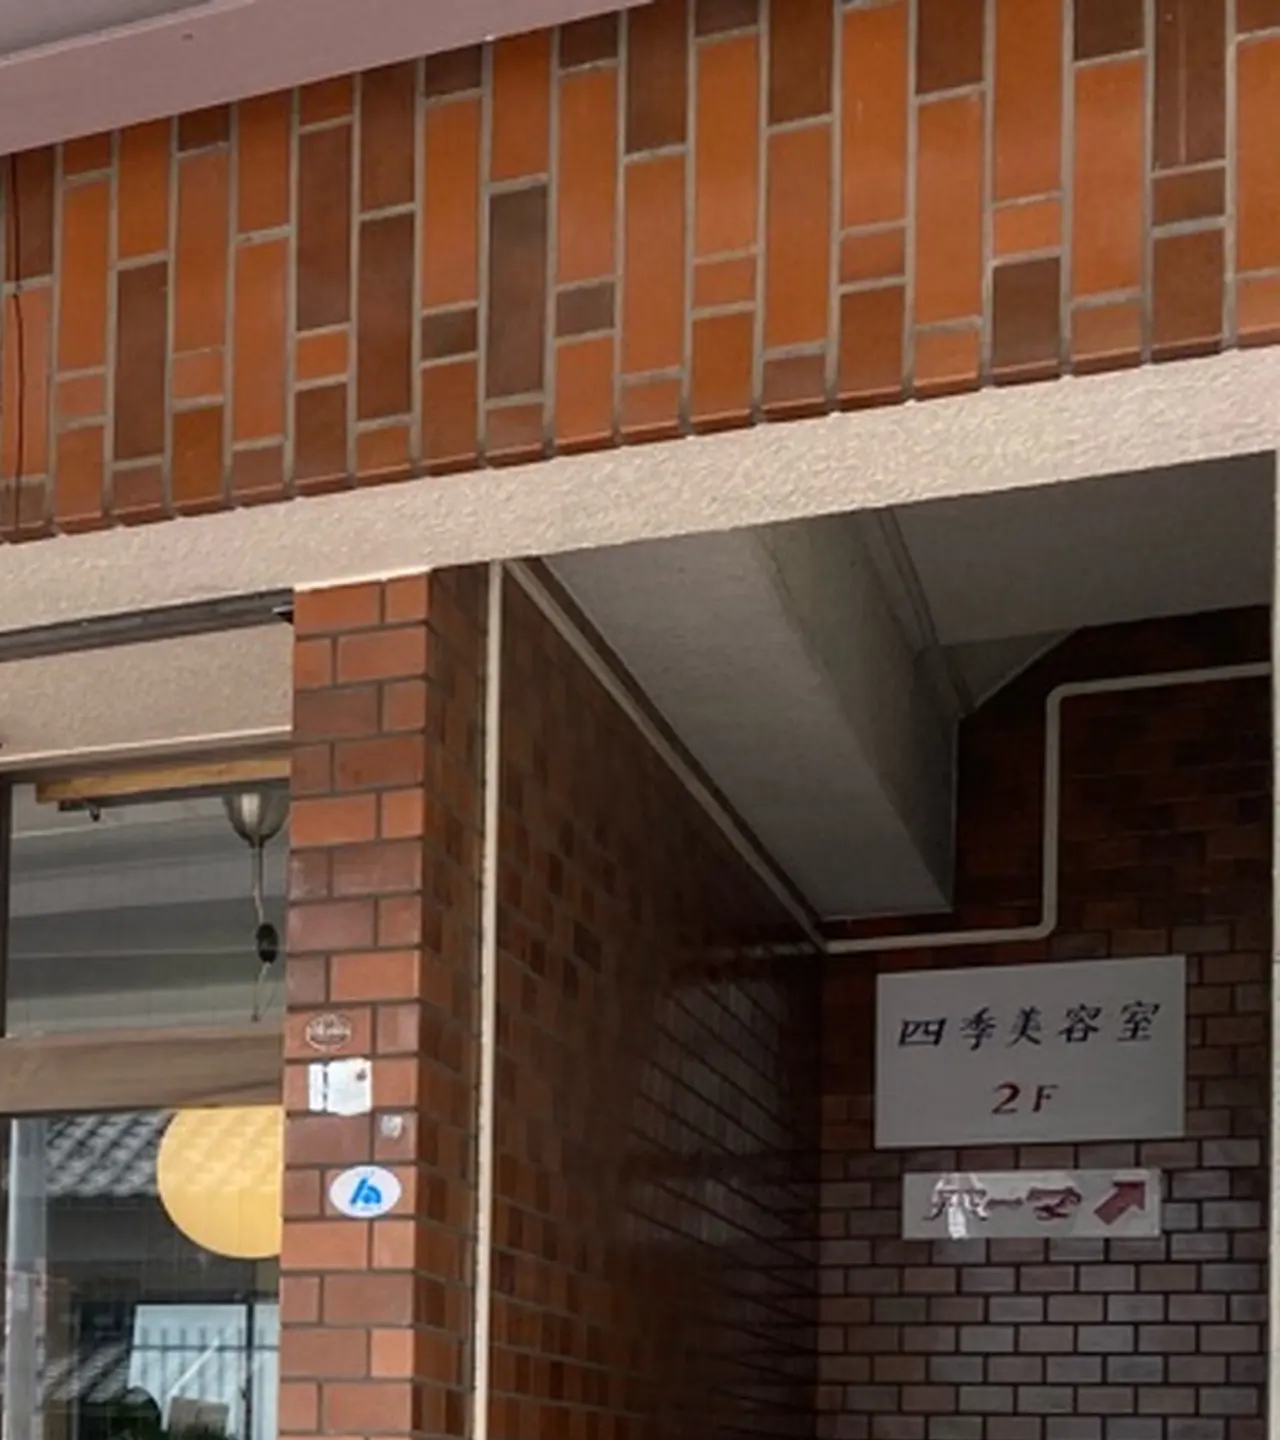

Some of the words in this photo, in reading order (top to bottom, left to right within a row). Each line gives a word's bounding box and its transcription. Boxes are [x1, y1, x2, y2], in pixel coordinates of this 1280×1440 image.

[897, 1001, 1161, 1051] 四季美容室
[991, 1081, 1059, 1115] 2F
